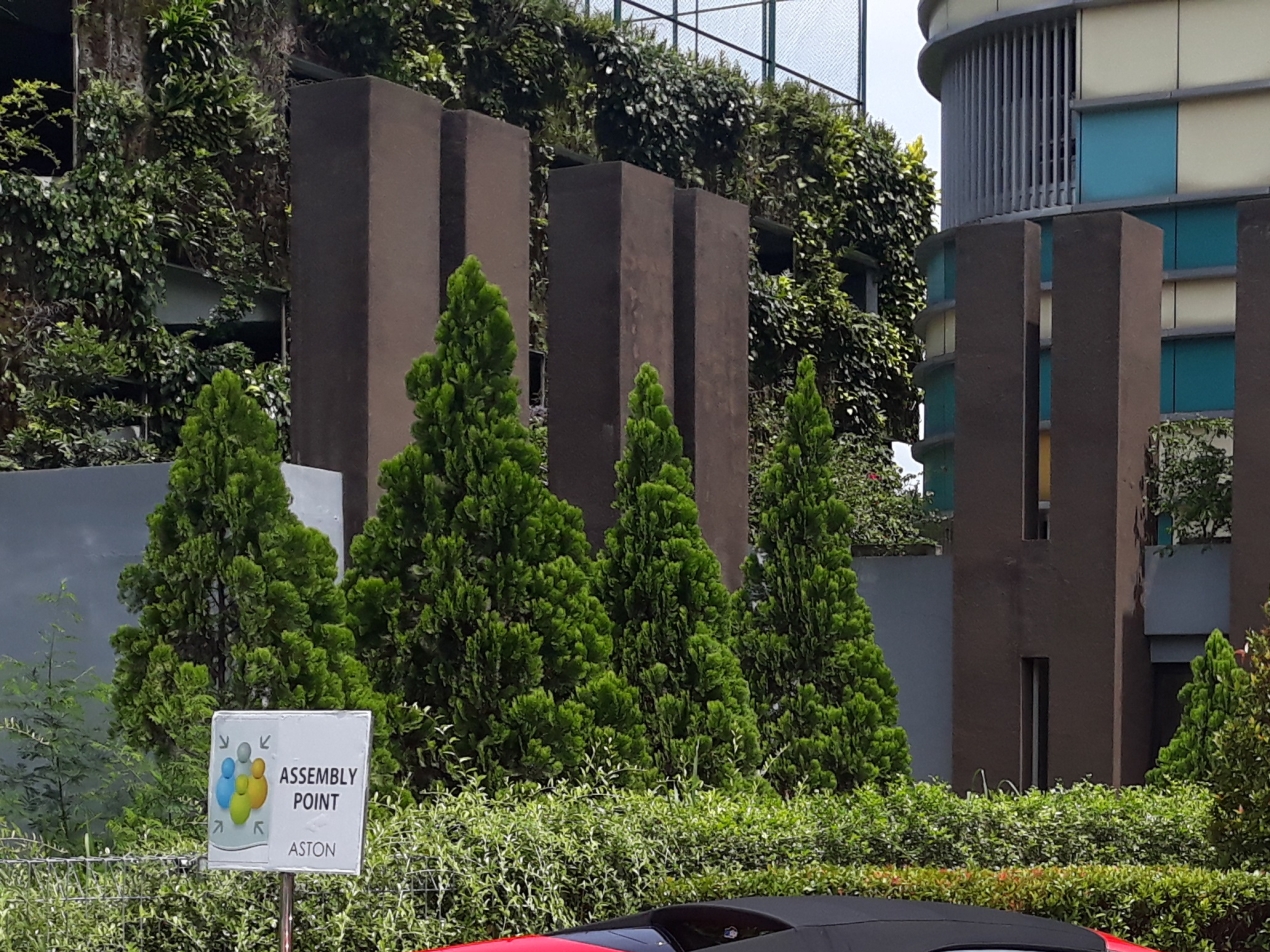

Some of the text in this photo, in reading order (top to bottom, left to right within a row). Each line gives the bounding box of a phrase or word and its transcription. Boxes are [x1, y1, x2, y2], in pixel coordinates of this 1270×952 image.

[279, 767, 358, 785] ASSEMBLY
[293, 792, 340, 811] POINT
[288, 841, 336, 857] ASTON
